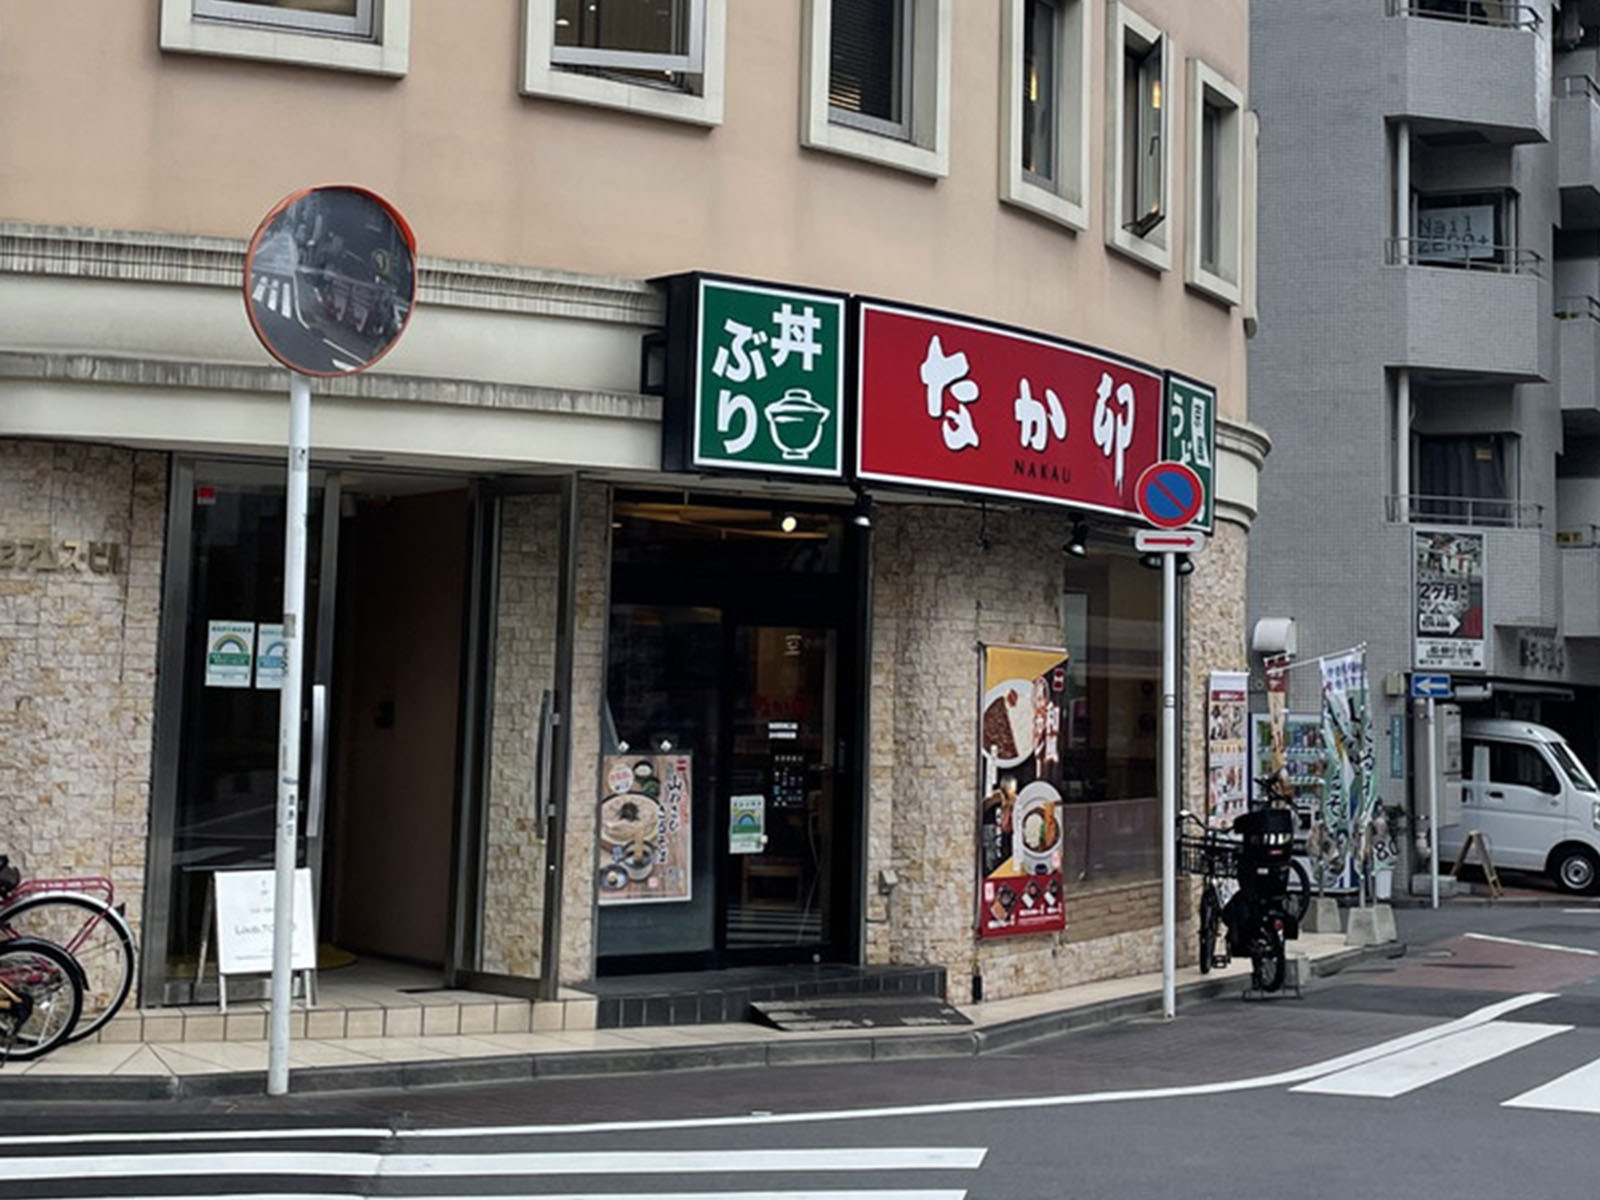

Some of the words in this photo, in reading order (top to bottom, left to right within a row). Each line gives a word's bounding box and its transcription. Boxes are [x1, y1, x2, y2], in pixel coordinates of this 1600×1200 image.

[712, 318, 768, 455] ぶり
[770, 303, 823, 372] 丼
[920, 335, 1135, 496] なか卯
[1014, 459, 1071, 484] NAKAU
